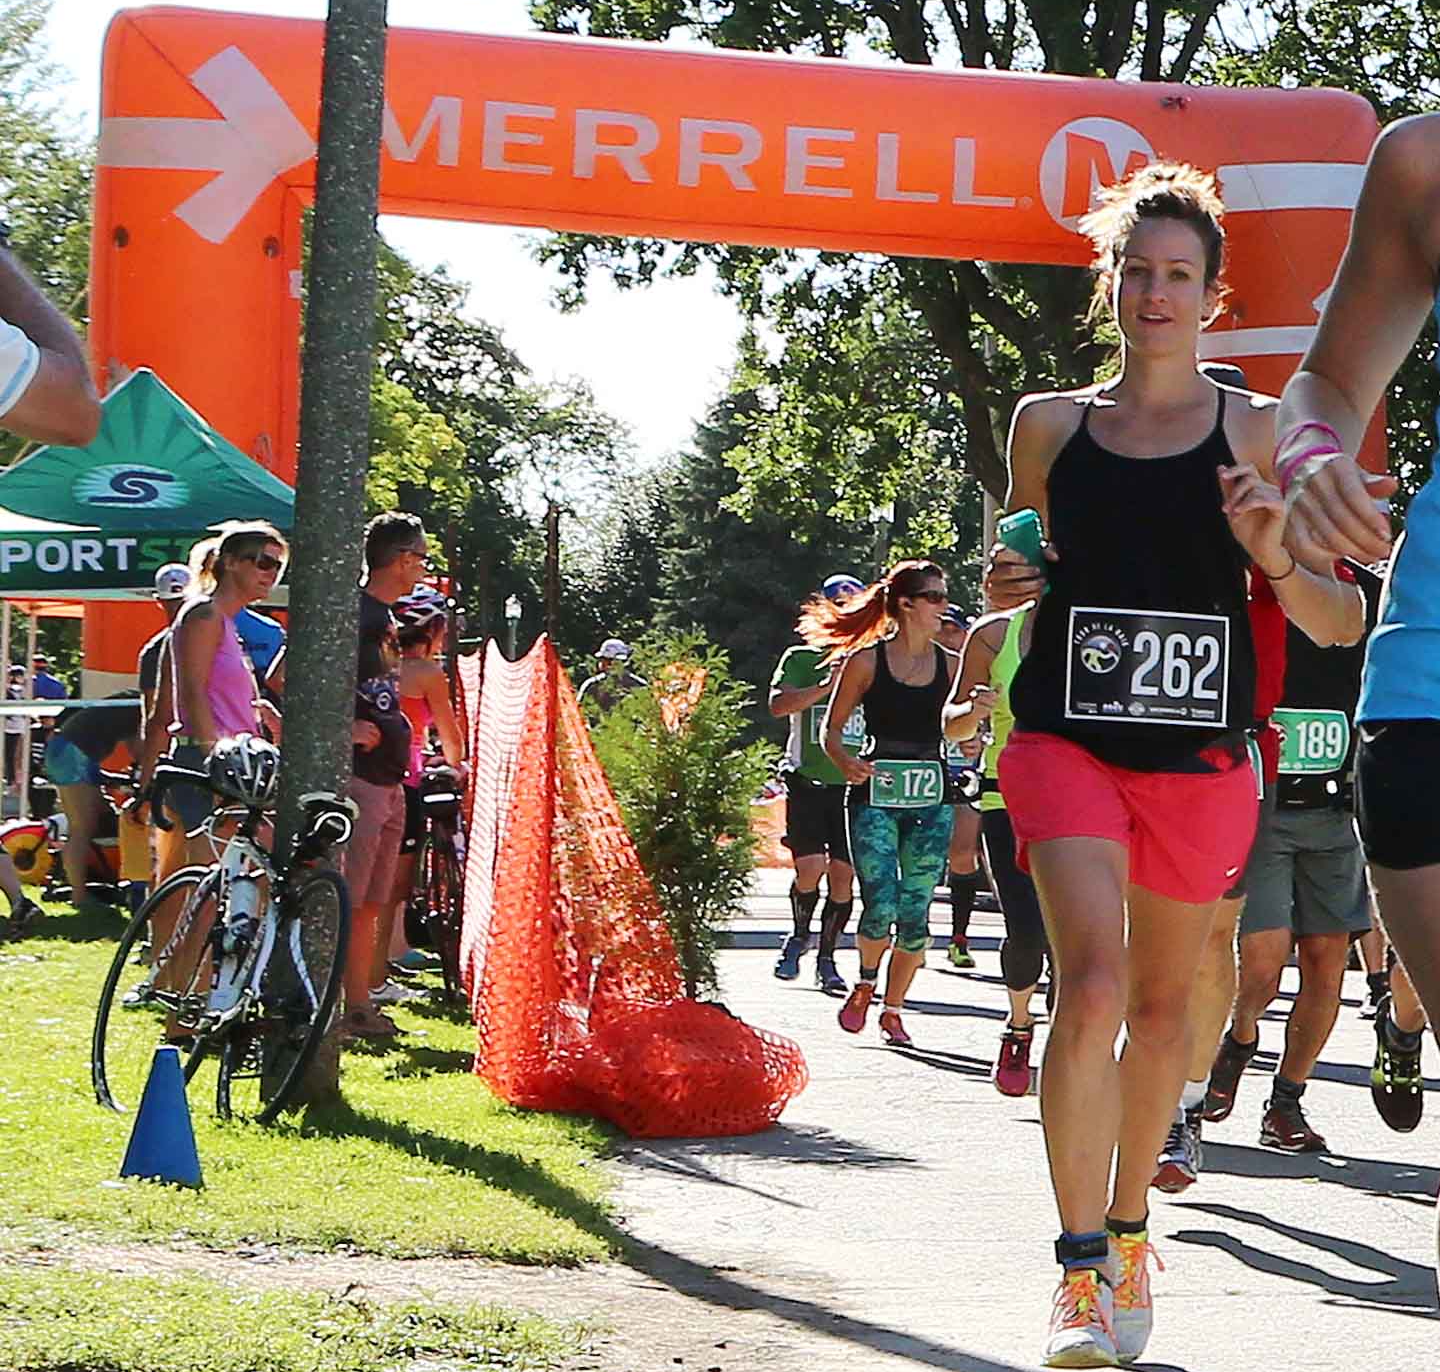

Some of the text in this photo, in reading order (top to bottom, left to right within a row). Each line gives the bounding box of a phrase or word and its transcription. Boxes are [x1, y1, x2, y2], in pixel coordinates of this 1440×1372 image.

[382, 96, 1016, 208] MERRELL
[1130, 631, 1220, 700] 262
[1296, 721, 1342, 759] 189
[901, 768, 937, 798] 172
